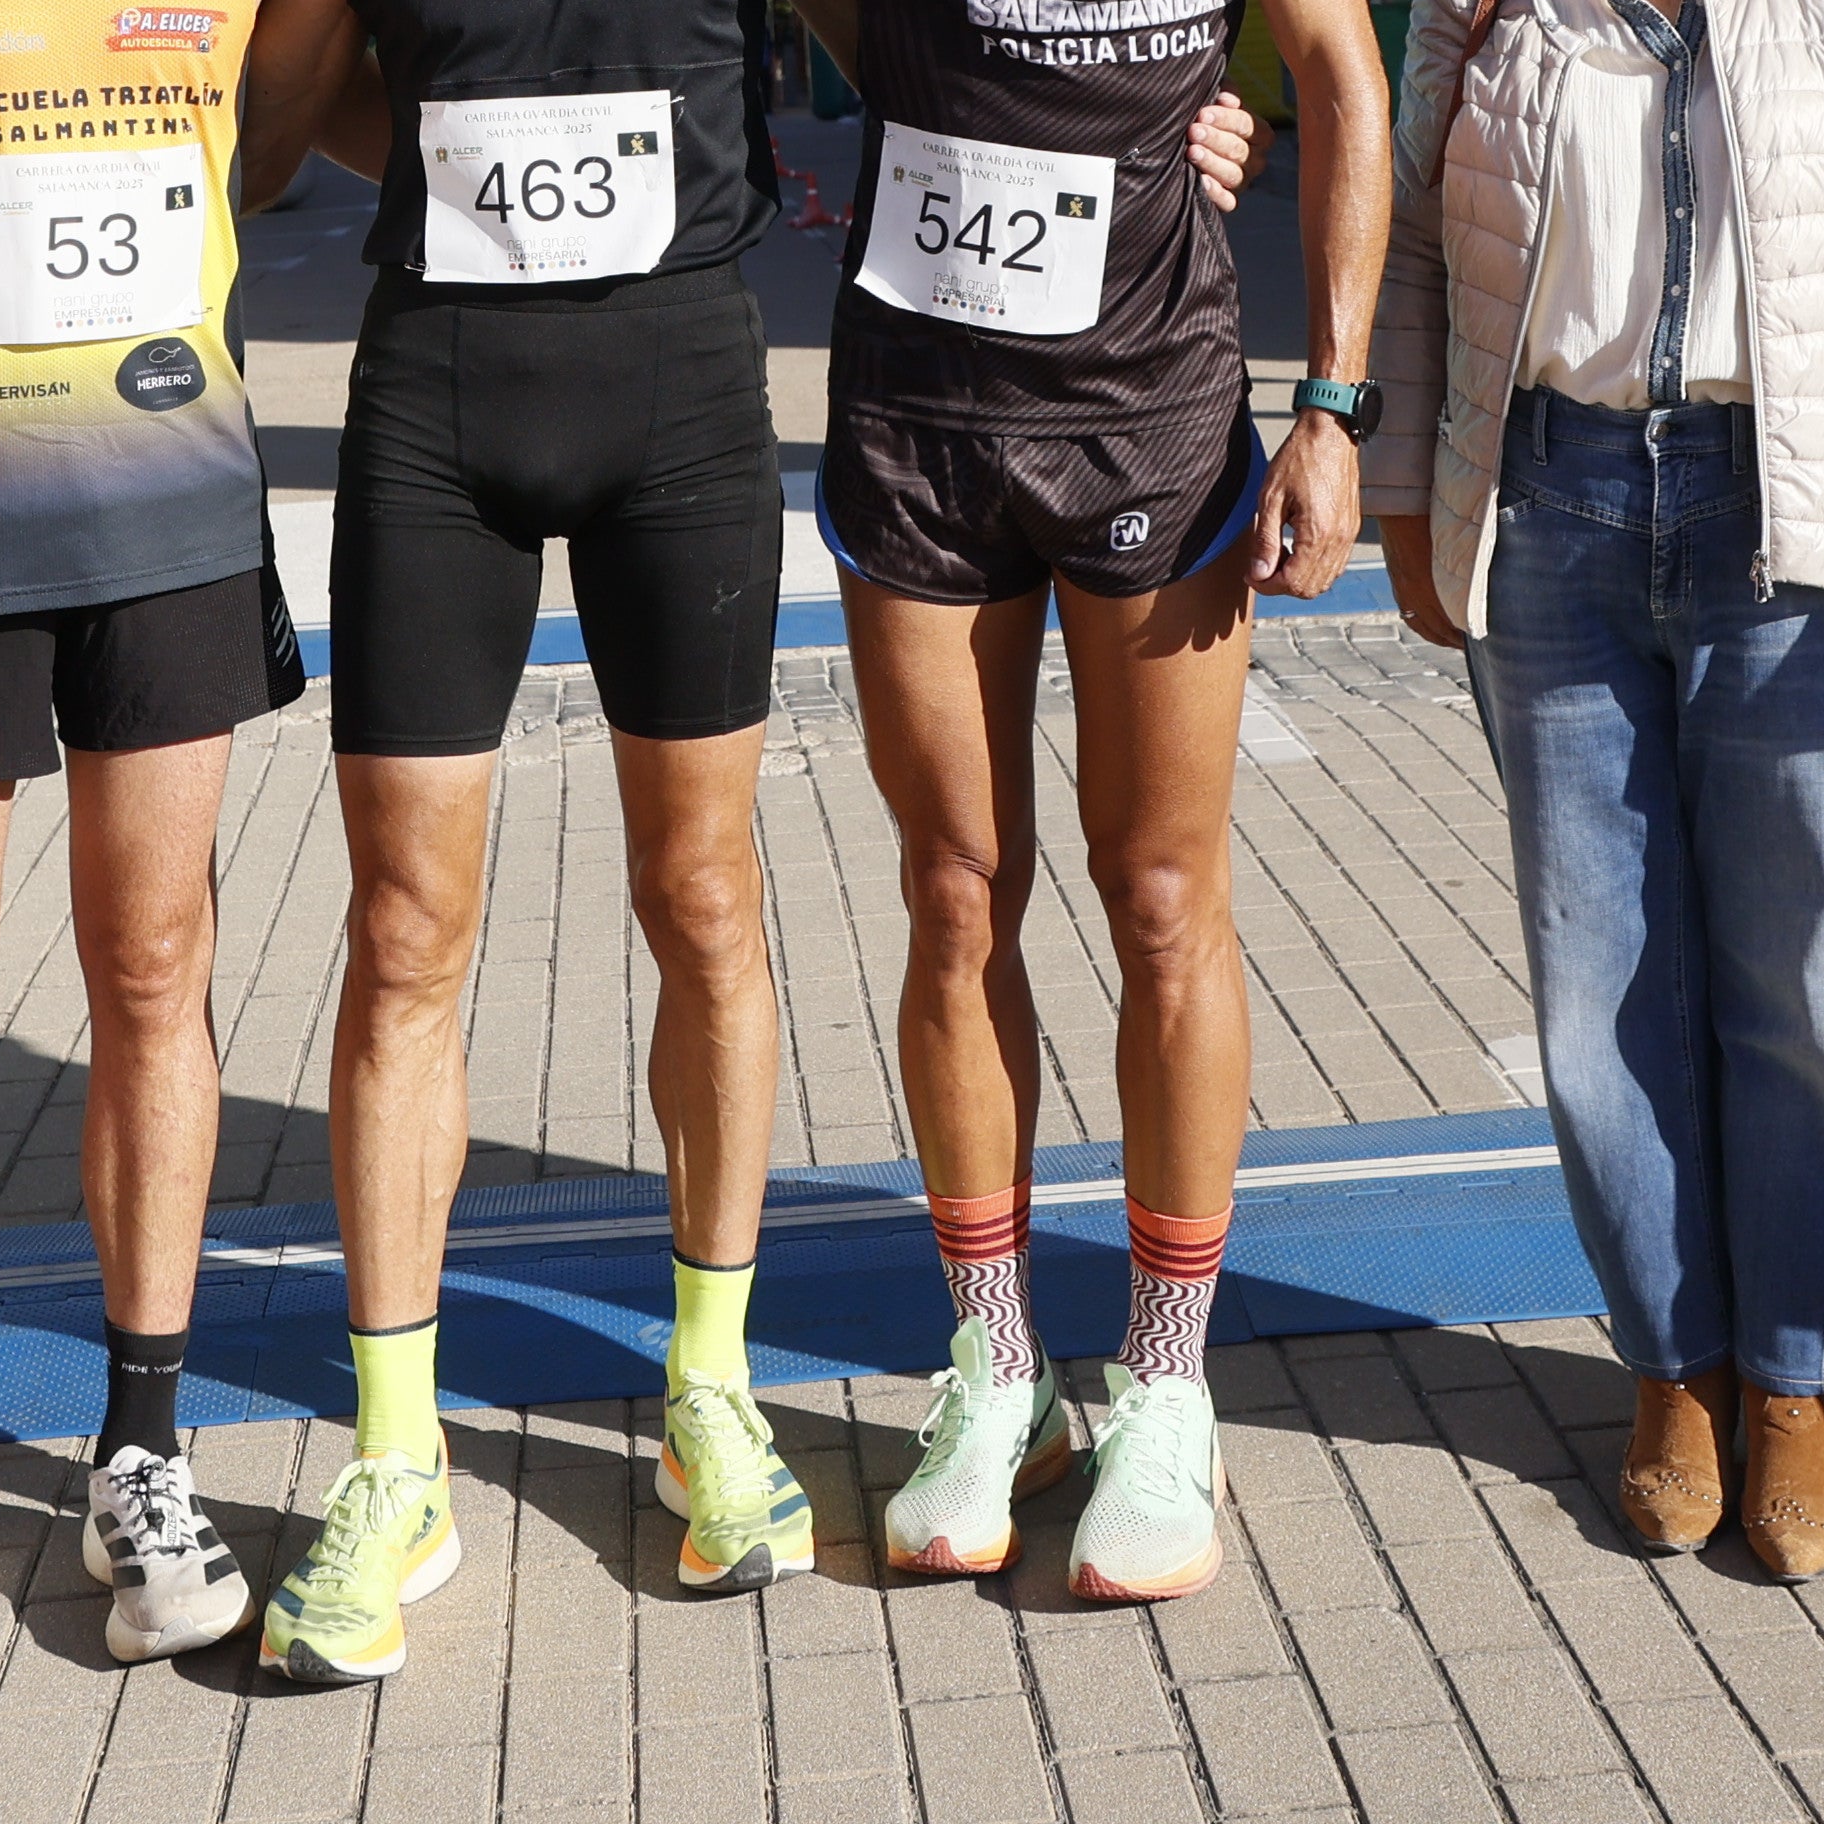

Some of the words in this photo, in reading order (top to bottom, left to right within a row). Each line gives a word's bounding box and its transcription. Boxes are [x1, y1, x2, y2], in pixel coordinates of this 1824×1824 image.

[159, 13, 212, 33] ELICES
[120, 37, 193, 49] AUTOESCUELA
[983, 33, 1118, 66] POLICIA
[1128, 21, 1215, 63] LOCAL
[464, 109, 521, 124] CARRERA
[486, 126, 560, 139] SALAMANCA
[563, 123, 593, 135] 2025
[451, 146, 484, 156] ALCER
[922, 141, 969, 160] CARRERA
[15, 165, 73, 178] CARRERA
[936, 161, 1003, 183] SALAMANCA
[1006, 174, 1035, 187] 2025
[38, 180, 111, 193] SALAMANCA
[115, 178, 144, 190] 2025
[474, 156, 616, 224] 463
[914, 190, 1048, 274] 542
[46, 212, 140, 280] 53
[506, 237, 537, 251] nani
[541, 235, 587, 253] grupo
[507, 250, 587, 263] EMPRESARIAL
[933, 271, 963, 286] nani
[966, 278, 1010, 297] grupo
[53, 293, 86, 307] nani
[90, 291, 135, 310] grupo
[932, 285, 1007, 308] EMPRESARIAL
[53, 307, 134, 321] EMPRESARIAL
[136, 374, 193, 392] HERRERO
